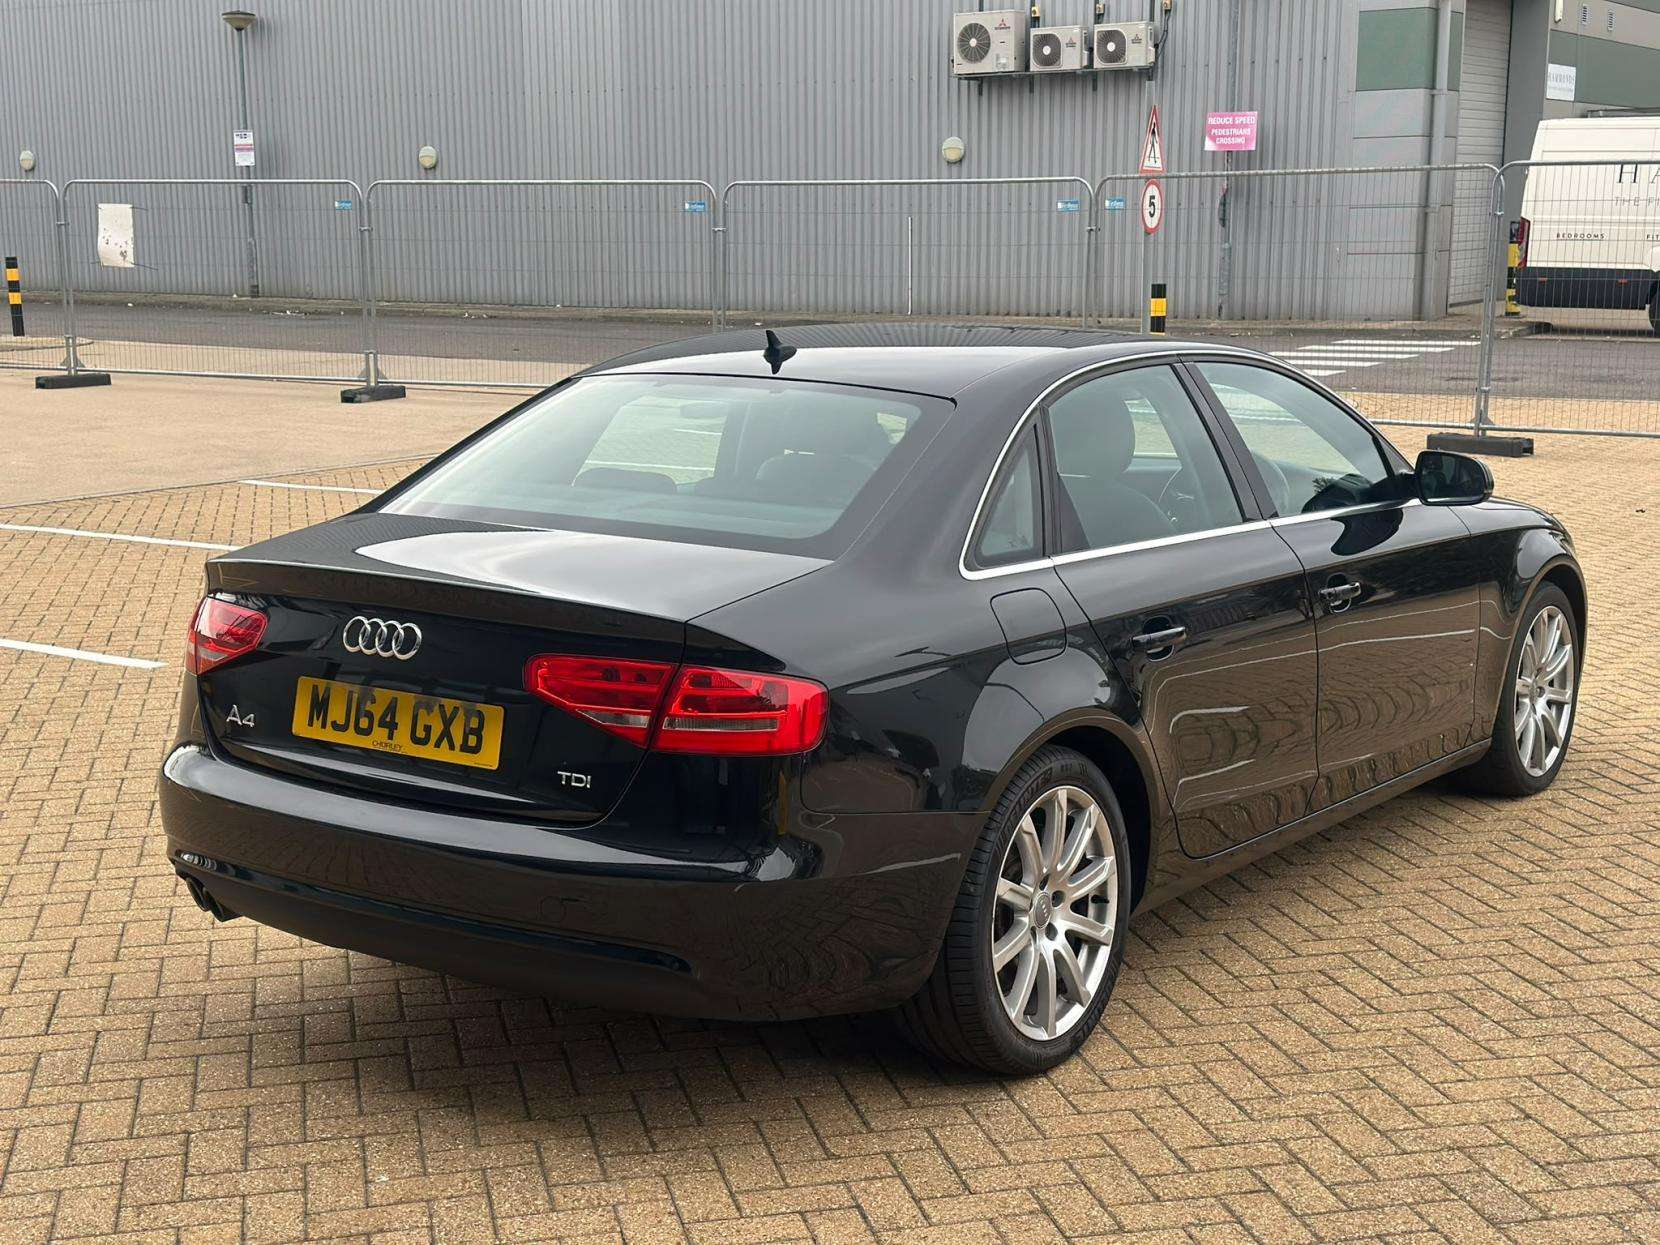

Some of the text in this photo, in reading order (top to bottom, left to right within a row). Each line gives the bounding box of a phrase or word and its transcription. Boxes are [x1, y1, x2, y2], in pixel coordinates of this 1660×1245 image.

[1235, 116, 1255, 124] SPEED
[1211, 128, 1251, 136] PEDESTRIANS
[1148, 194, 1156, 218] 5
[226, 704, 255, 728] A4
[307, 684, 486, 755] MJ64 GXB
[557, 770, 592, 789] TDI
